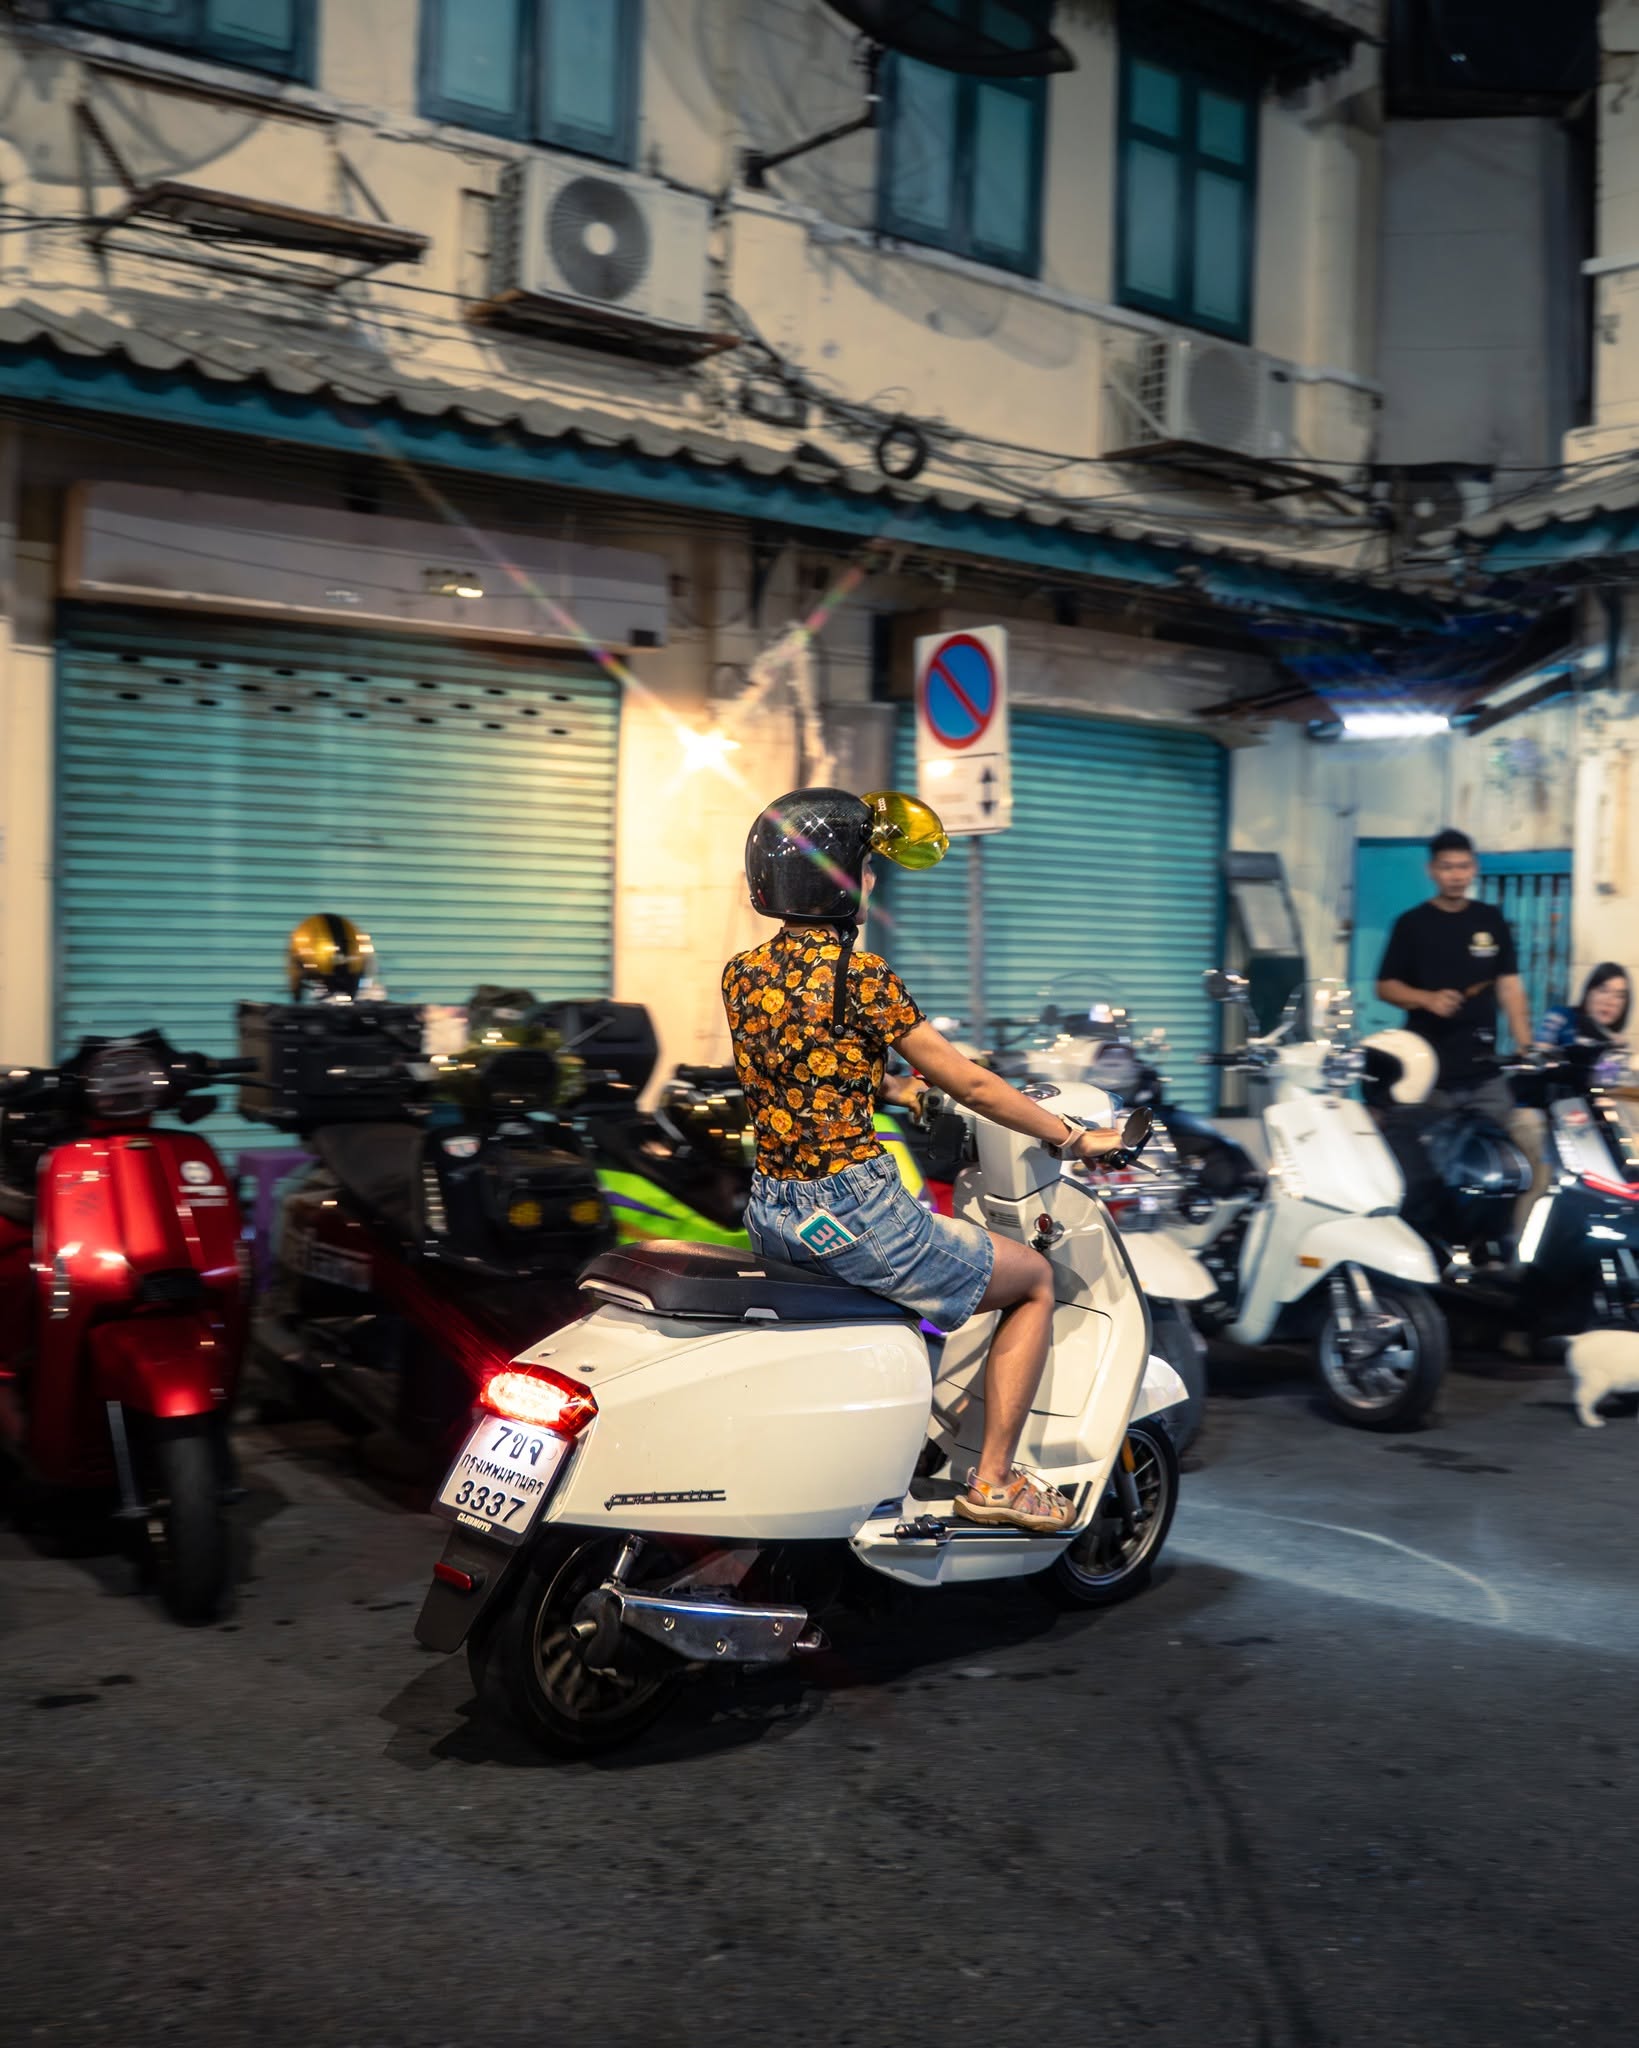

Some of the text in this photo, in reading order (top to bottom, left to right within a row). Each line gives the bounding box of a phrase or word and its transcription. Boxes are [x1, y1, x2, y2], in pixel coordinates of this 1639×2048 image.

[461, 1453, 545, 1496] กรุงเทพมหานคร
[455, 1480, 527, 1524] 3337
